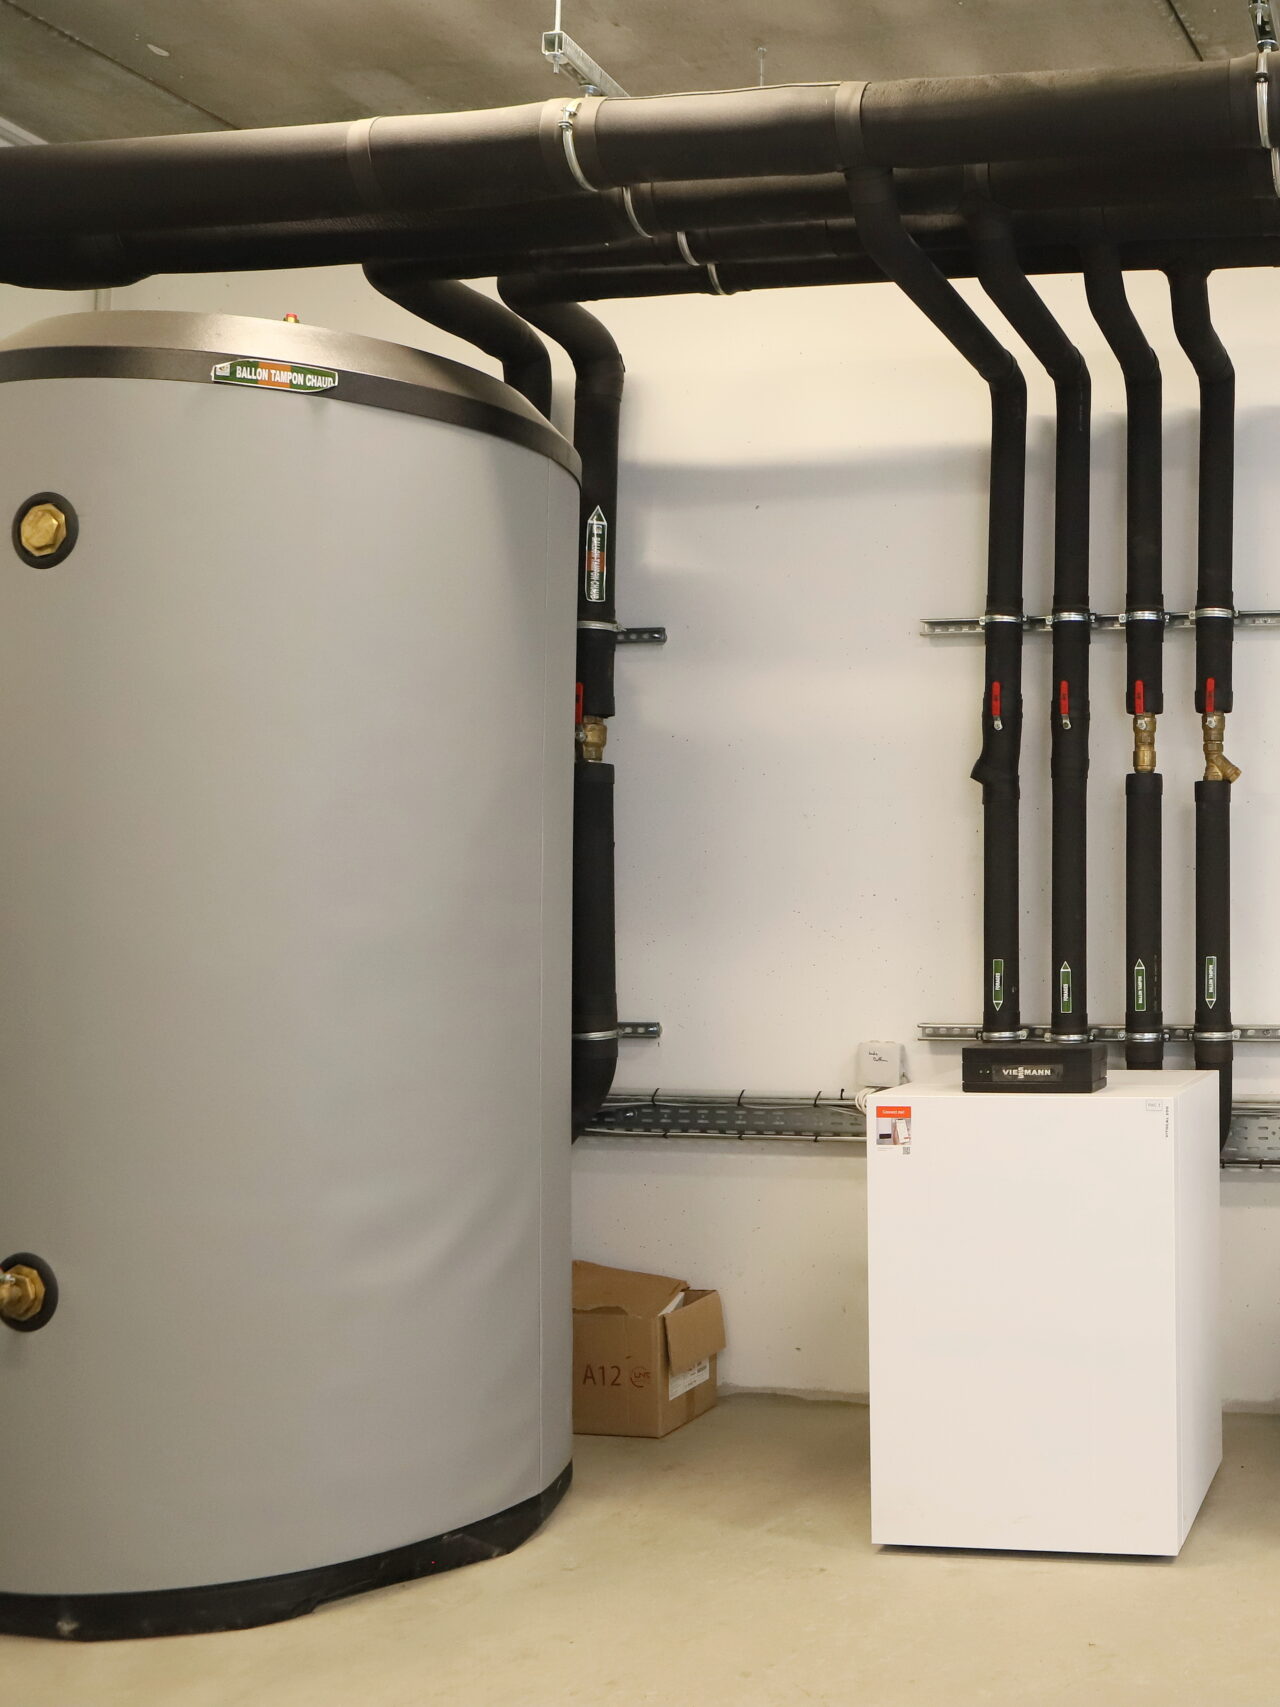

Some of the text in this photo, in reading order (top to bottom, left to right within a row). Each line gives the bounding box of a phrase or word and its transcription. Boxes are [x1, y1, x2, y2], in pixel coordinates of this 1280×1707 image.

[235, 365, 334, 388] BALLON TAMPON CHAUD
[590, 536, 601, 600] BALLON TAMPON CHAUD
[1002, 1066, 1051, 1079] VIESSMANN
[582, 1364, 622, 1387] A12
